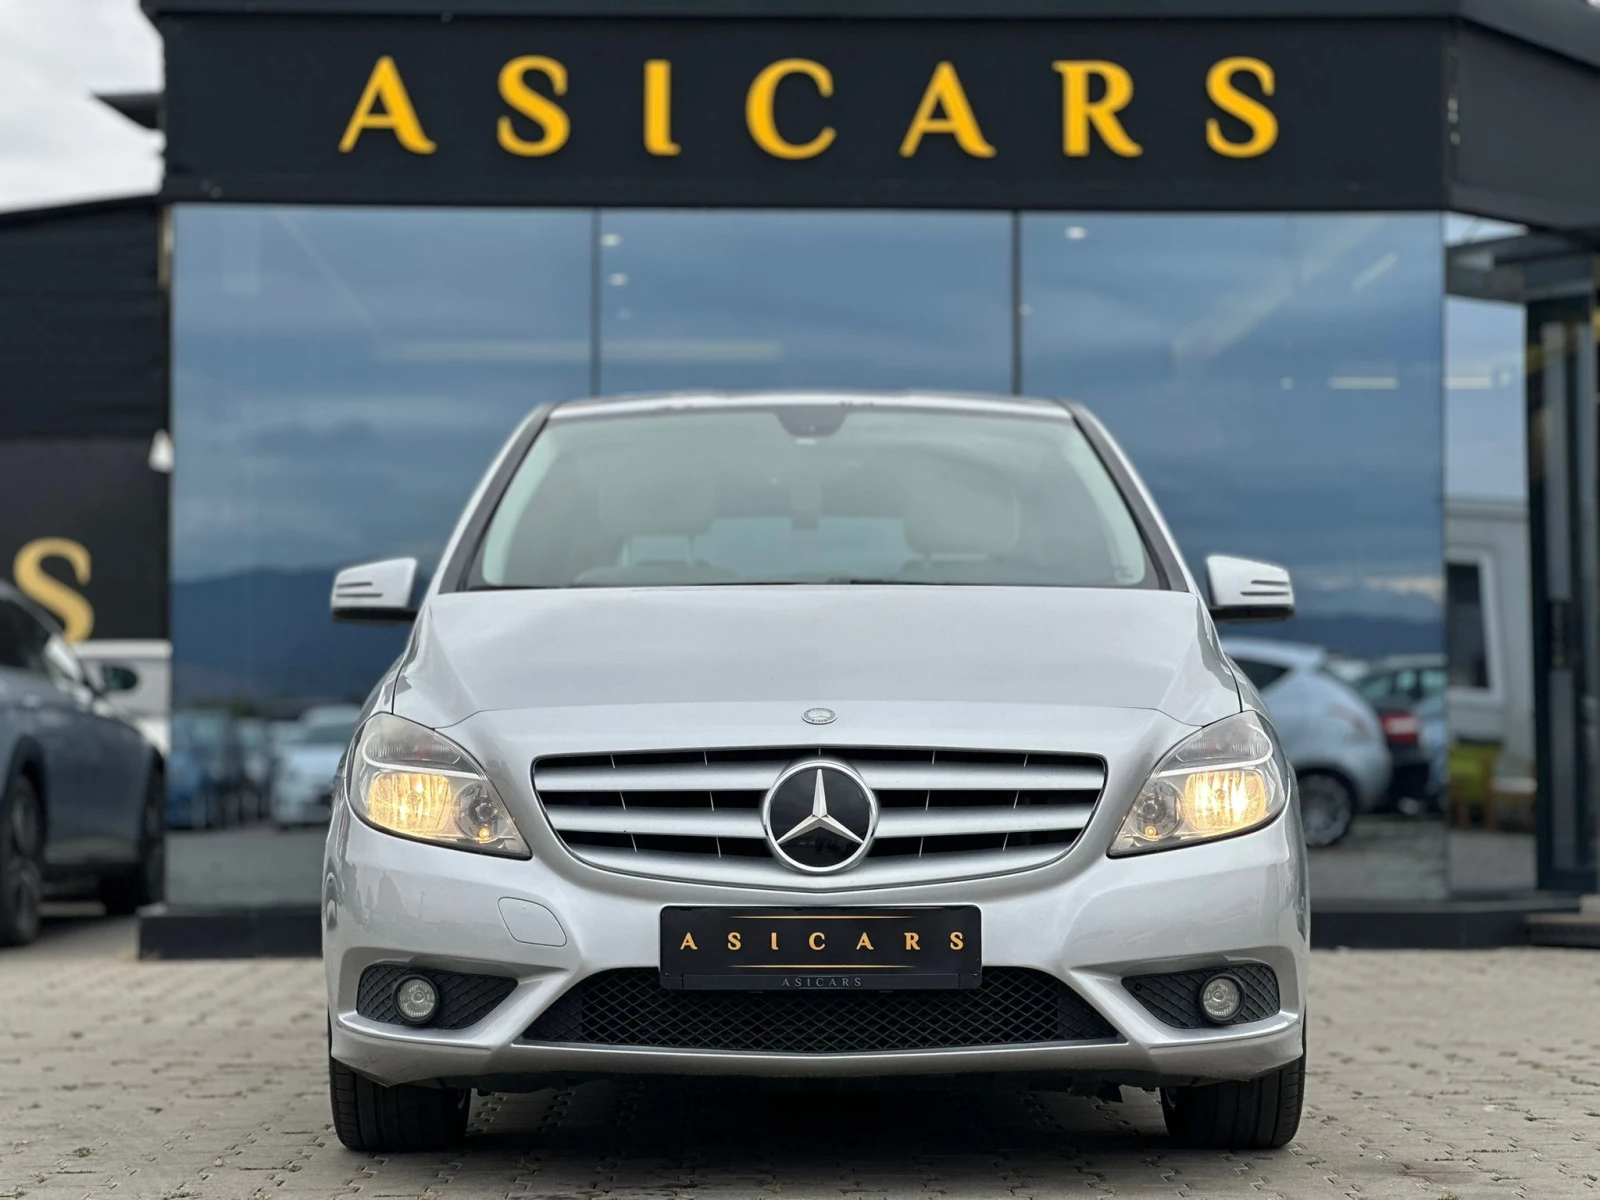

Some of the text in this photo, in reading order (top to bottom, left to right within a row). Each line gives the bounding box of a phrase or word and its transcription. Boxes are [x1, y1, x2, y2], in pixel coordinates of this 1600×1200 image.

[338, 55, 1280, 160] ASICARS
[13, 536, 95, 645] S
[680, 931, 964, 951] ASICARS
[781, 977, 862, 987] ASICARS
